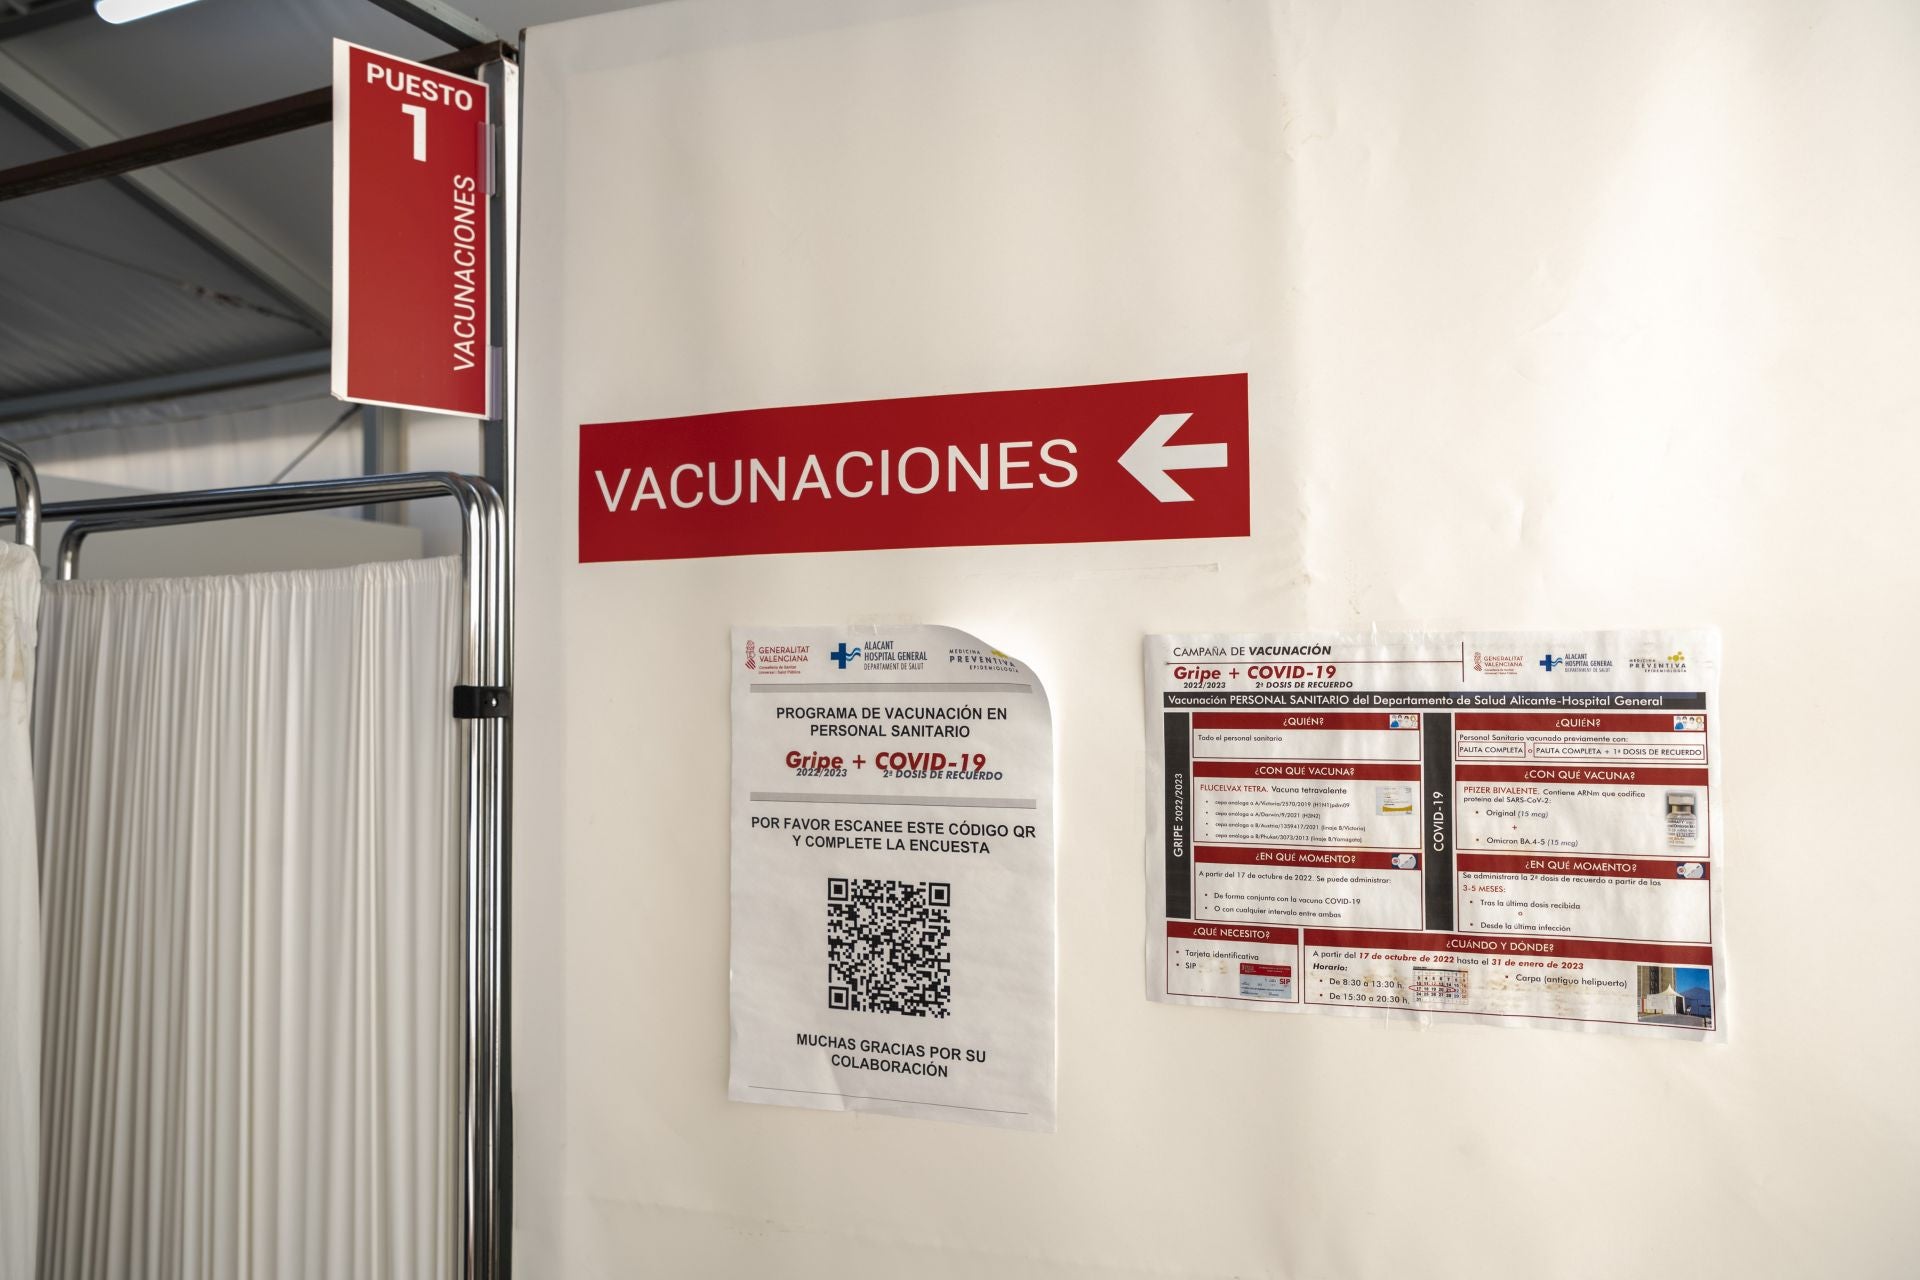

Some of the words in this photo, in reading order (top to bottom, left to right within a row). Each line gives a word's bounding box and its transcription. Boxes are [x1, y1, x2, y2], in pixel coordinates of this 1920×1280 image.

[368, 62, 472, 111] PUESTO
[402, 103, 426, 162] 1
[454, 174, 475, 371] VACUNACIONES
[595, 439, 1077, 512] VACUNACIONES
[865, 641, 893, 650] ALACANT
[1174, 646, 1226, 656] CAMPAÑA
[1231, 647, 1245, 655] DE
[1249, 644, 1331, 655] VACUNACIÓN
[865, 652, 895, 660] HOSPITAL
[898, 652, 927, 660] GENERAL
[950, 656, 1015, 667] PREVENTIVA
[1174, 666, 1221, 683] Gripe
[1229, 668, 1239, 678] +
[1248, 666, 1336, 679] COVID-19
[1168, 695, 1226, 704] Vacunación
[1231, 696, 1286, 704] PERSONAL
[1290, 695, 1349, 704] SANITARIO
[1353, 695, 1369, 704] del
[1374, 695, 1453, 706] Departamento
[1457, 695, 1470, 705] de
[1474, 696, 1506, 705] Salud
[1510, 696, 1610, 707] Alicante-Hospital
[1614, 696, 1663, 706] General
[777, 708, 857, 719] PROGRAMA
[862, 708, 881, 719] DE
[885, 704, 982, 720] VACUNACIÓN
[987, 708, 1007, 720] EN
[1283, 718, 1323, 726] ¿QUIÉN?
[1556, 718, 1601, 728] ¿QUIÉN?
[811, 725, 886, 736] PERSONAL
[892, 725, 970, 738] SANITARIO
[1224, 735, 1251, 743] personal
[786, 751, 843, 774] Gripe
[853, 755, 866, 768] +
[876, 752, 986, 772] COVID-19
[797, 768, 847, 778] 2022/2023
[896, 770, 927, 779] DOSIS
[930, 770, 943, 779] DE
[946, 771, 1002, 780] RECUERDO
[1255, 767, 1282, 776] ¿CON
[1286, 766, 1305, 776] QUÉ
[1308, 767, 1354, 776] VACUNA?
[1525, 771, 1554, 780] ¿CON
[1559, 770, 1581, 780] QUÉ
[1584, 771, 1634, 780] VACUNA?
[1200, 784, 1241, 792] FLUCELVAX
[1175, 773, 1183, 821] 2022/2023
[1518, 810, 1528, 818] (15
[752, 817, 779, 829] POR
[784, 818, 830, 830] FAVOR
[835, 820, 902, 833] ESCANEE
[907, 822, 944, 835] ESTE
[949, 820, 1008, 837] CÓDIGO
[1013, 825, 1036, 838] QR
[1433, 792, 1444, 851] COVID-19
[792, 835, 800, 846] Y
[805, 836, 882, 849] COMPLETE
[887, 839, 905, 850] LA
[910, 839, 990, 854] ENCUESTA
[1174, 824, 1183, 857] GRIPE
[1256, 853, 1273, 861] ¿EN
[1277, 852, 1296, 862] QUÉ
[1299, 854, 1355, 863] MOMENTO?
[1526, 861, 1545, 869] ¿EN
[1548, 860, 1570, 870] QUÉ
[1574, 863, 1636, 872] MOMENTO?
[1193, 927, 1217, 937] ¿QUÉ
[1221, 929, 1269, 939] NECESITO?
[1447, 938, 1498, 950] ¿CUÁNDO
[1510, 941, 1553, 952] DÓNDE?
[1186, 949, 1210, 959] Tarjeta
[1213, 951, 1259, 960] identificativa
[1320, 952, 1346, 960] partir
[1420, 954, 1430, 962] de
[1433, 955, 1454, 963] 2022
[1457, 957, 1478, 965] hasta
[1492, 958, 1501, 966] 31
[1505, 958, 1515, 967] de
[1562, 961, 1584, 969] 2023
[1313, 963, 1348, 972] Horario:
[1343, 978, 1361, 986] 8:30
[1516, 974, 1541, 983] Carpa
[1544, 975, 1579, 986] (antiguo
[1581, 977, 1628, 988] helipuerto)
[1343, 993, 1365, 1001] 15:30
[797, 1034, 856, 1050] MUCHAS
[860, 1040, 925, 1057] GRACIAS
[930, 1046, 961, 1060] POR
[966, 1050, 986, 1062] SU
[831, 1055, 948, 1077] COLABORACIÓN
